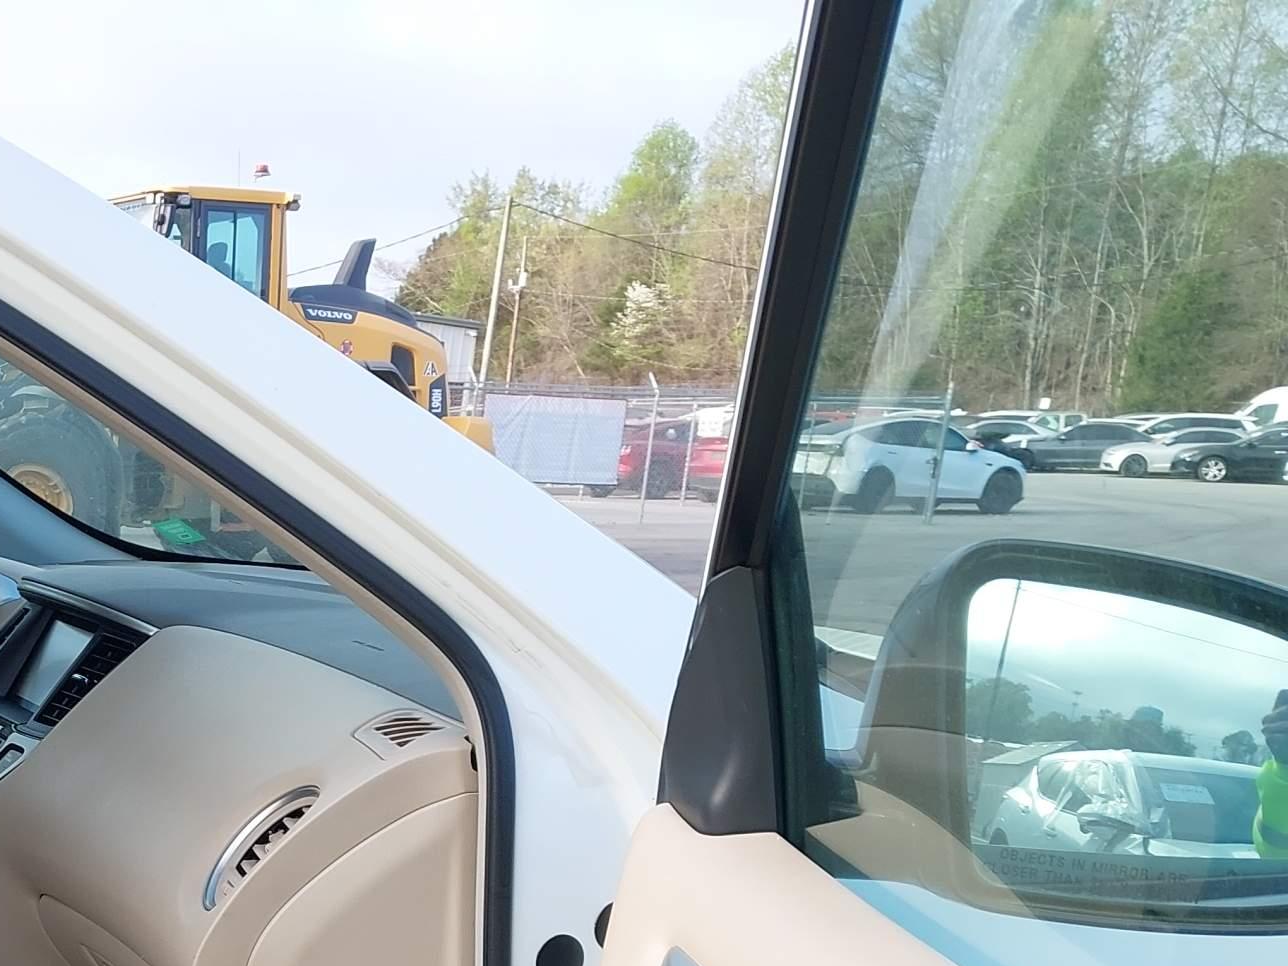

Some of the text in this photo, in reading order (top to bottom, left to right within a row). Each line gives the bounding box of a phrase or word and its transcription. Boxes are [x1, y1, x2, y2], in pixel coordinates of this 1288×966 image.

[306, 308, 353, 321] VOLVO
[431, 388, 443, 413] L90H
[999, 849, 1066, 869] OBJECTS
[1071, 859, 1086, 872] IN
[1090, 861, 1150, 881] MIRROR
